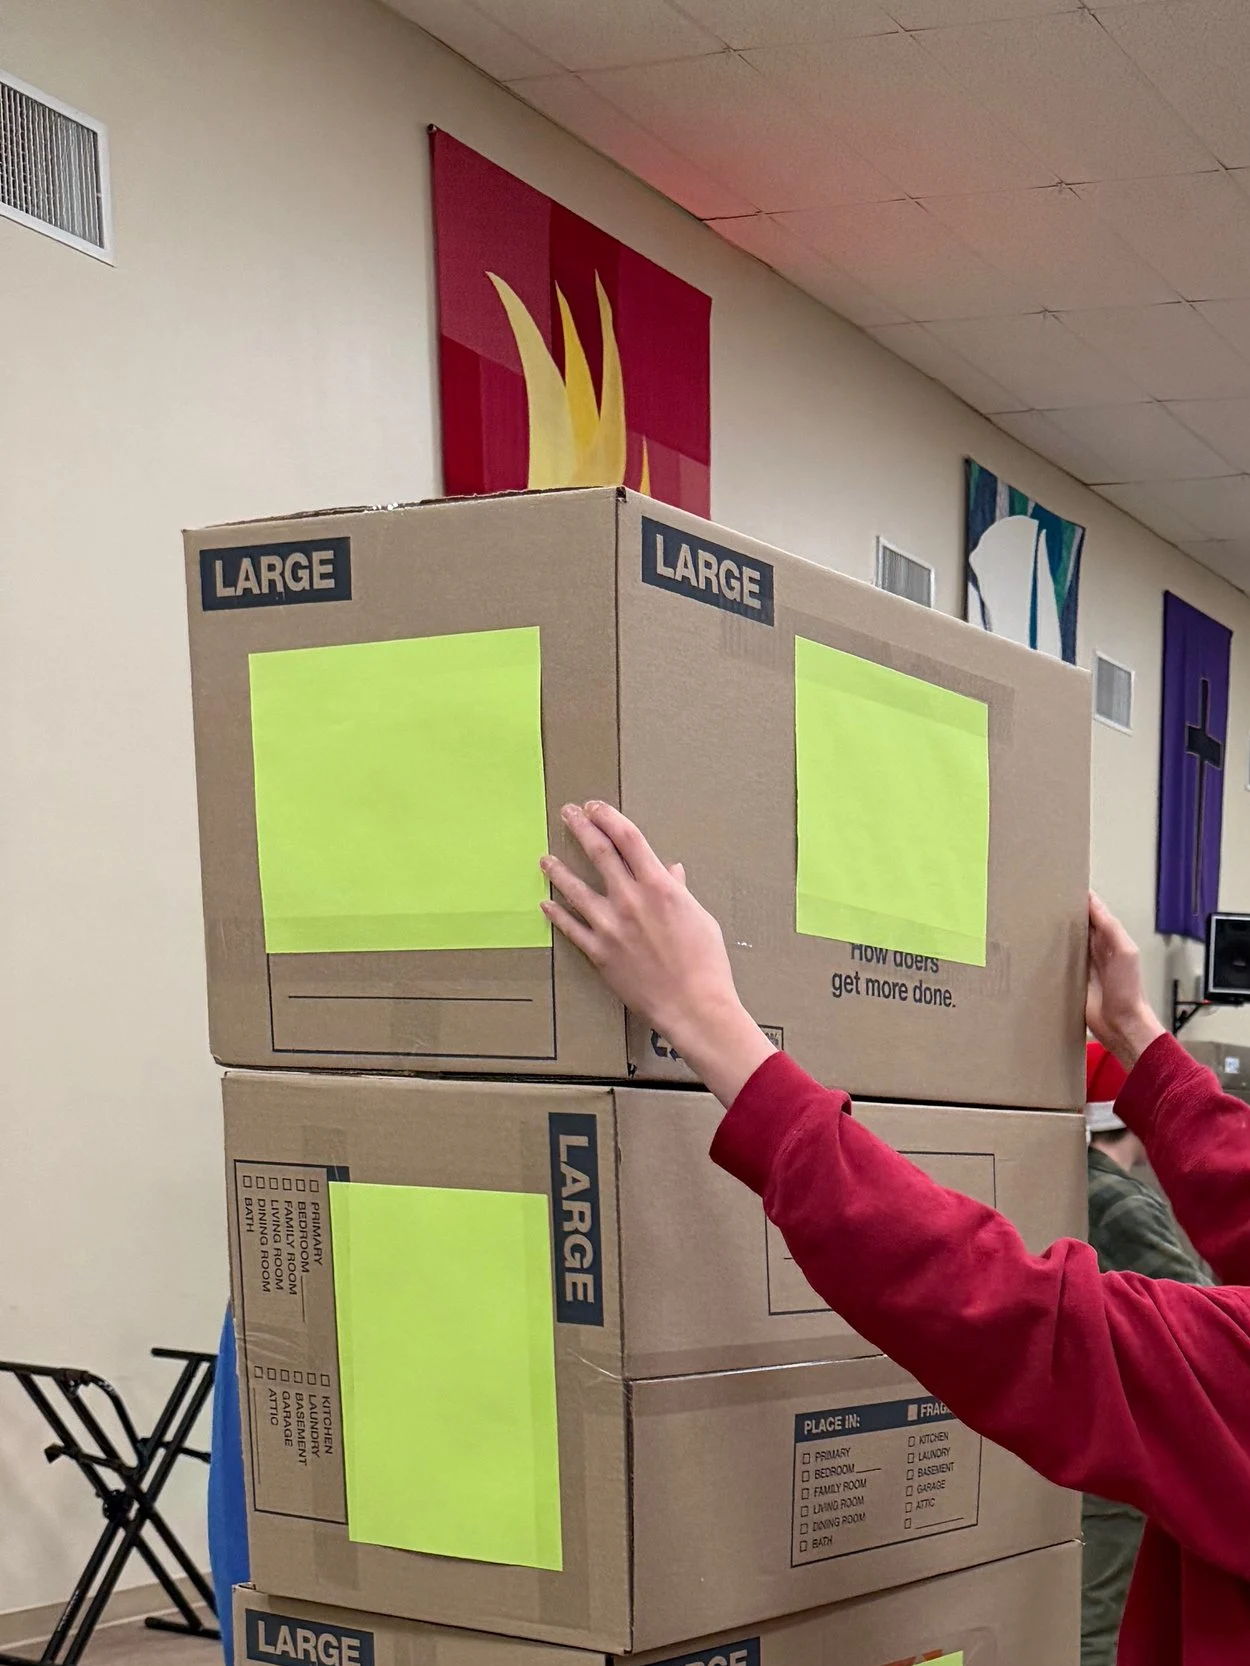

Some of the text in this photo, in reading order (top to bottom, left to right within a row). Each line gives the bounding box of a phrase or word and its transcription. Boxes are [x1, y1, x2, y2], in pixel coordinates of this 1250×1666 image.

[215, 550, 335, 598] LARGE
[656, 533, 762, 610] LARGE
[831, 971, 957, 1008] get more done.
[244, 1197, 254, 1232] BATH
[558, 1134, 595, 1304] LARGE
[257, 1198, 270, 1293] DINING ROOM
[271, 1200, 284, 1291] LIVING ROOM
[284, 1200, 297, 1295] FAMILY ROOM
[297, 1201, 310, 1273] BEDROOM
[311, 1202, 323, 1267] PRIMARY
[268, 1388, 279, 1426] ATTIC
[282, 1390, 293, 1447] GARAGE
[322, 1395, 333, 1455] KITCHEN
[803, 1413, 860, 1435] PLACE IN:
[920, 1402, 952, 1417] FRAG
[295, 1392, 307, 1466] BASEMENT
[308, 1394, 320, 1458] LAUNDRY
[919, 1431, 949, 1444] KITCHEN
[814, 1464, 855, 1480] BEDROOM
[815, 1447, 851, 1462] PRIMARY
[917, 1462, 955, 1478] BASEMENT
[918, 1447, 951, 1461] LAUNDRY
[813, 1478, 867, 1498] FAMILY ROOM
[915, 1497, 936, 1510] ATTIC
[916, 1479, 946, 1494] GARAGE
[812, 1512, 866, 1532] DINING ROOM
[813, 1496, 865, 1514] LIVING ROOM
[812, 1535, 833, 1549] BATH
